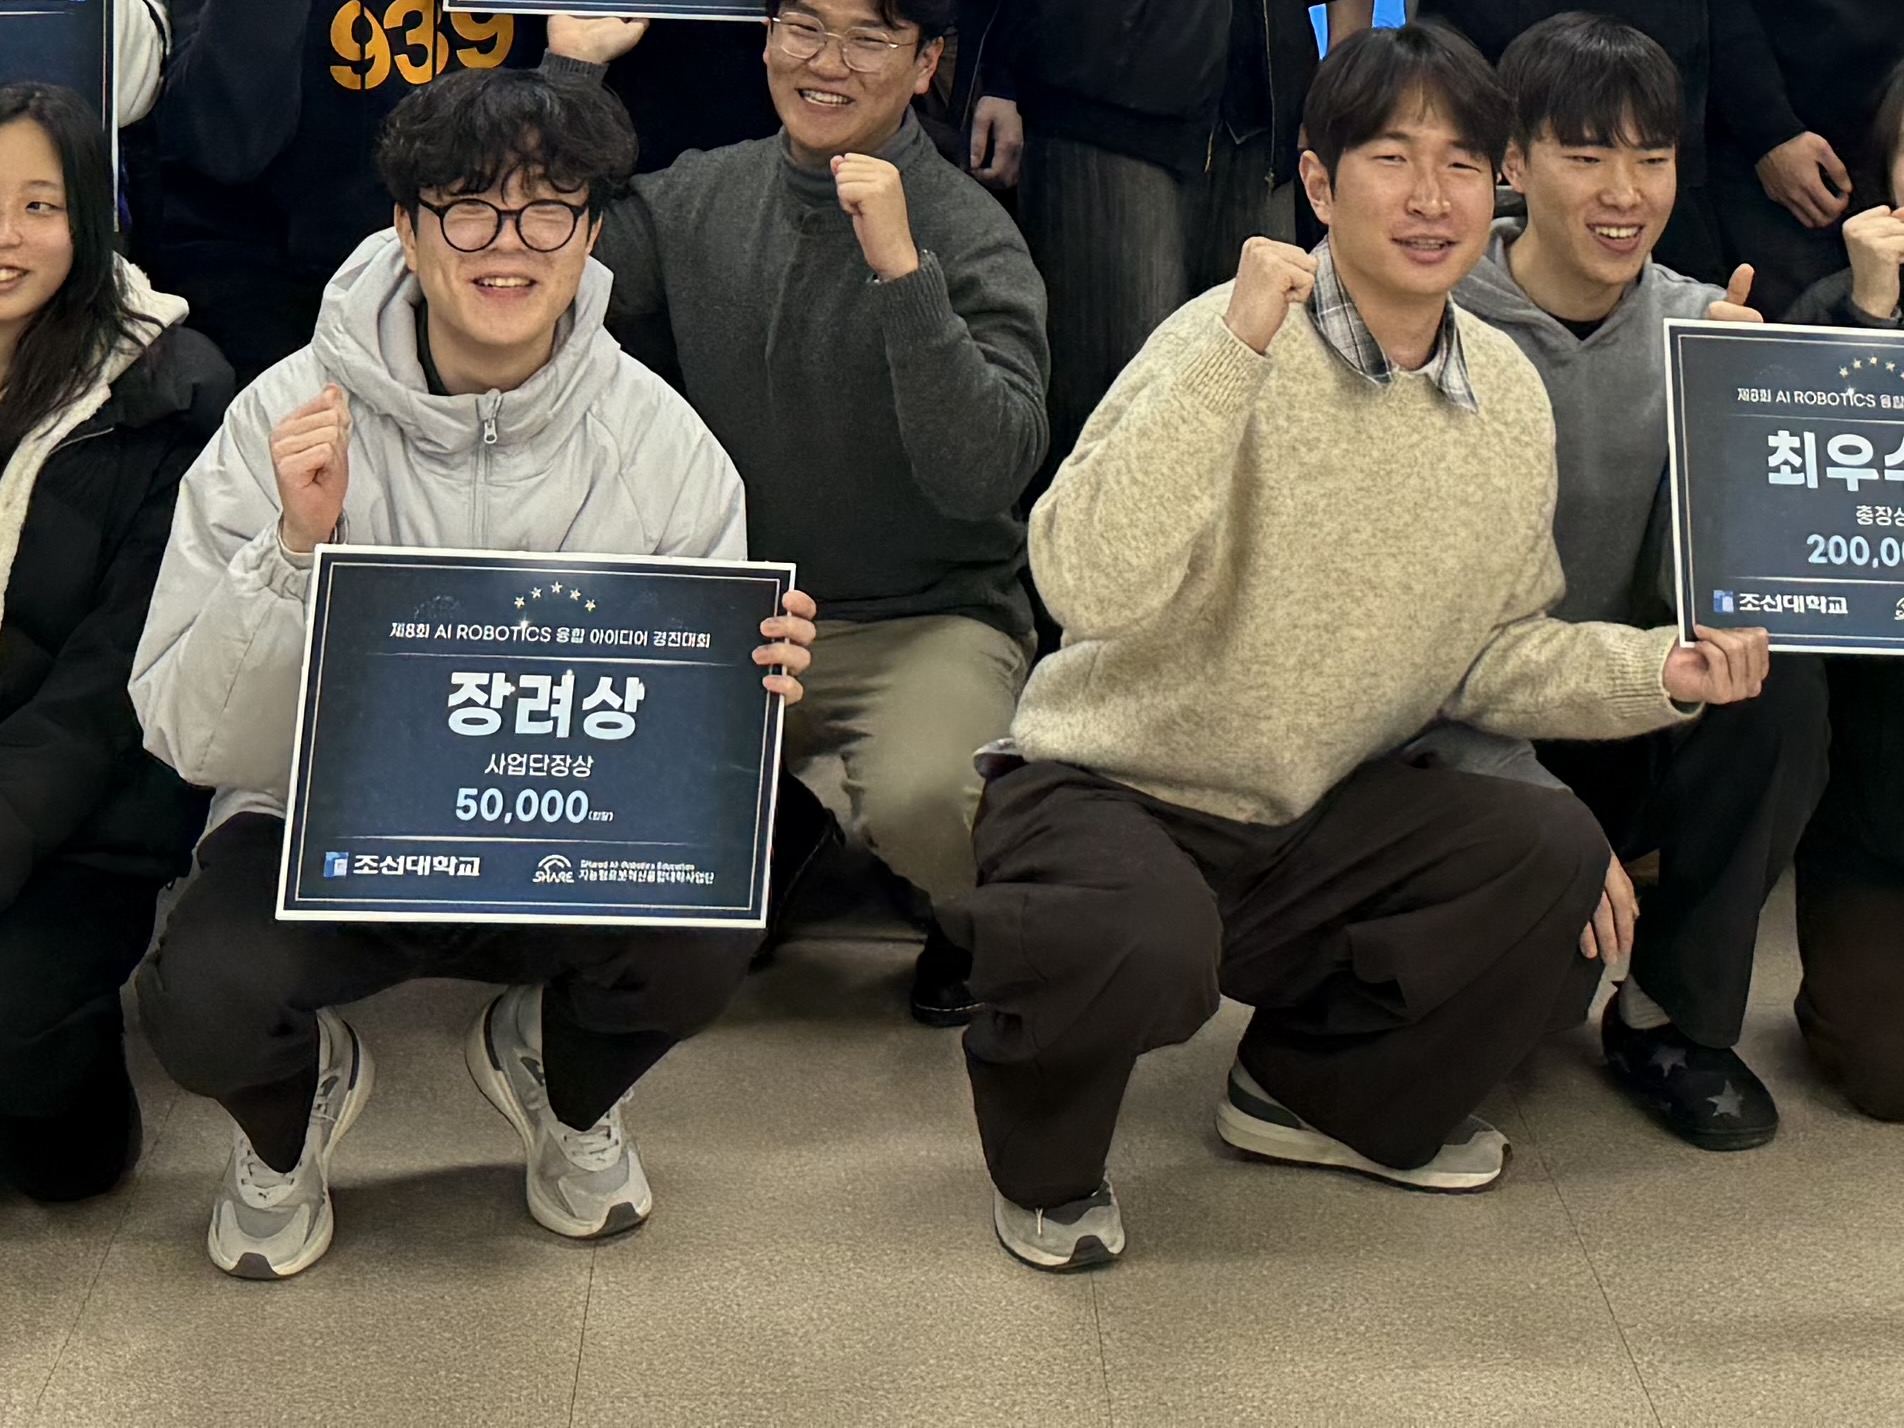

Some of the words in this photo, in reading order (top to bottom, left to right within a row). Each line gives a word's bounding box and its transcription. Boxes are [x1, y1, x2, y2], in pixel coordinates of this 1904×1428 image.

[1775, 390, 1791, 404] AI
[1794, 390, 1876, 408] ROBOTICS
[1738, 592, 1849, 615] 조선대학교
[389, 622, 431, 640] 제8회
[434, 623, 453, 640] AI
[455, 623, 552, 644] ROBOTICS
[589, 627, 649, 647] 아이디어
[653, 629, 711, 649] 경진대회
[447, 669, 645, 741] 장려상
[483, 753, 594, 778] 사업단장상
[455, 786, 589, 825] 50,000
[352, 854, 481, 878] 조선대학교
